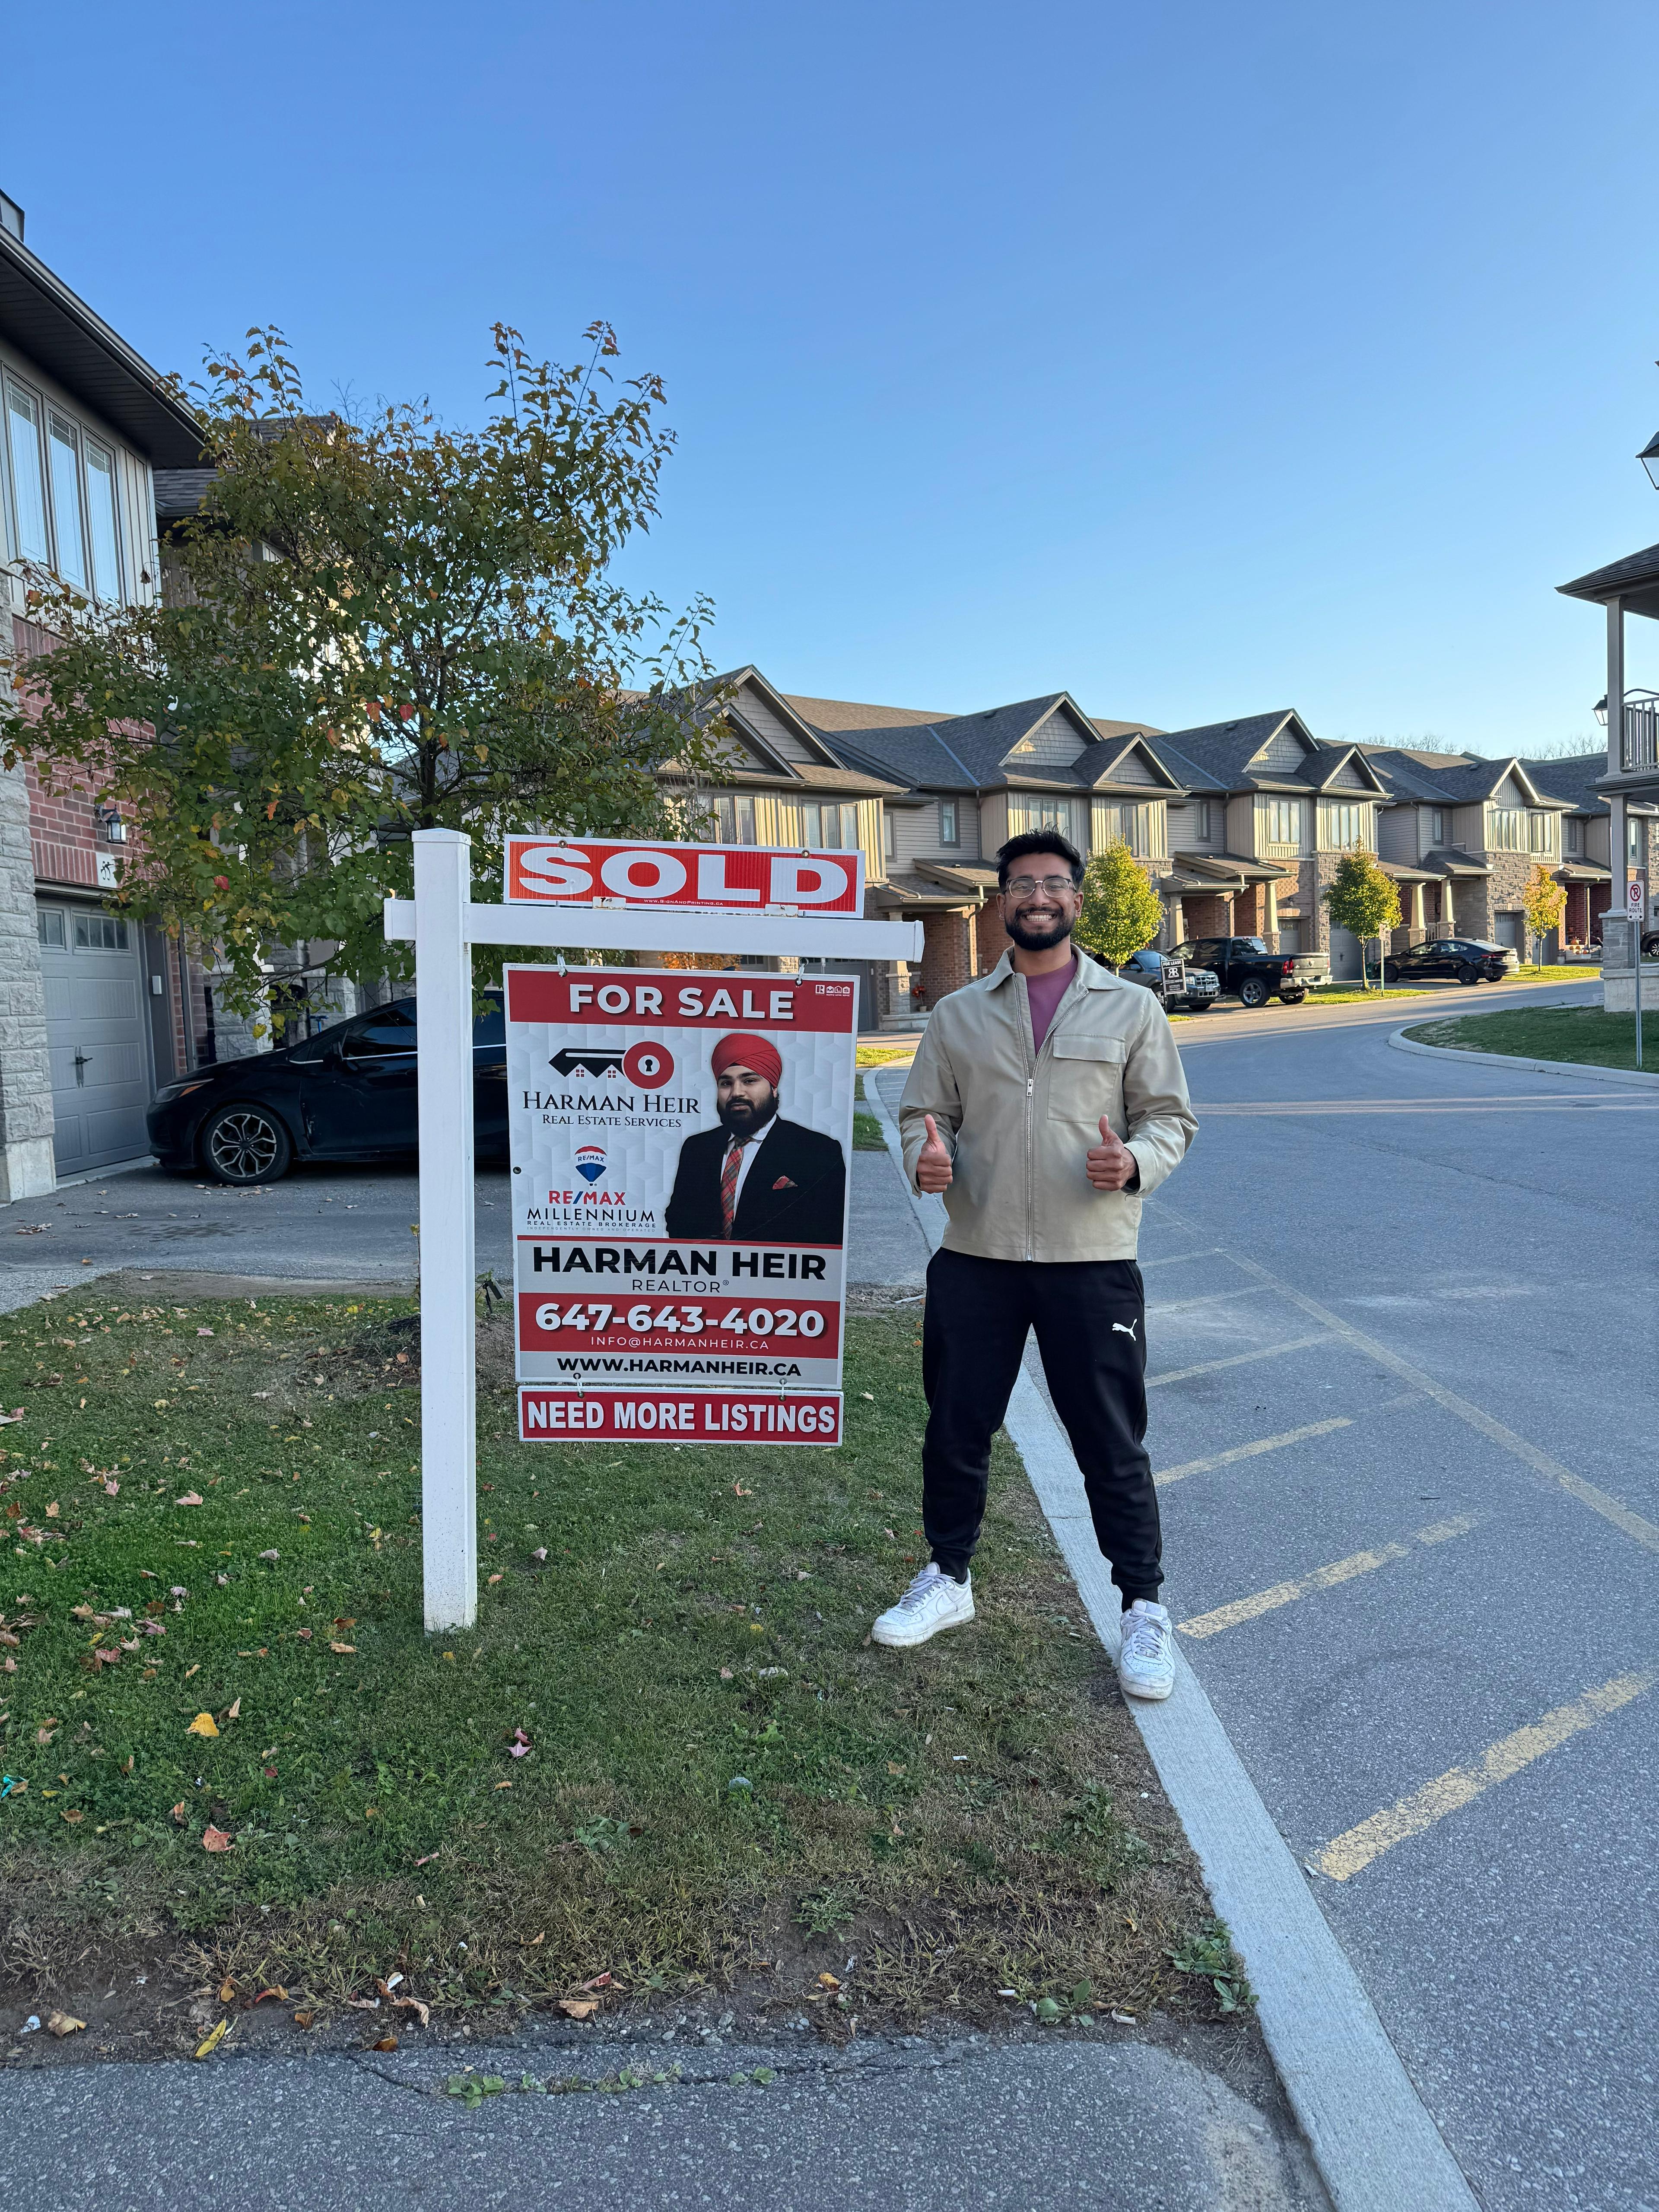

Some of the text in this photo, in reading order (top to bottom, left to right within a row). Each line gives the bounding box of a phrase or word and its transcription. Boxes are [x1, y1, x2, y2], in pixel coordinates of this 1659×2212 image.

[519, 847, 848, 903] SOLD
[570, 984, 794, 1019] FOR SALE
[523, 1091, 701, 1114] HARMAN HEIR
[543, 1114, 681, 1127] REAL ESTATE SERVICES
[549, 1191, 626, 1205] RE/MAX
[527, 1208, 655, 1222] MILLENNIUM
[534, 1247, 826, 1280] HARMAN HEIR
[536, 1303, 824, 1337] 647-643-4020
[591, 1337, 769, 1349] INFO@HARMANHEIR.CA
[557, 1358, 801, 1376] WWW.HARMANHEIR.CA
[528, 1401, 835, 1433] NEED MORE LISTINGS
